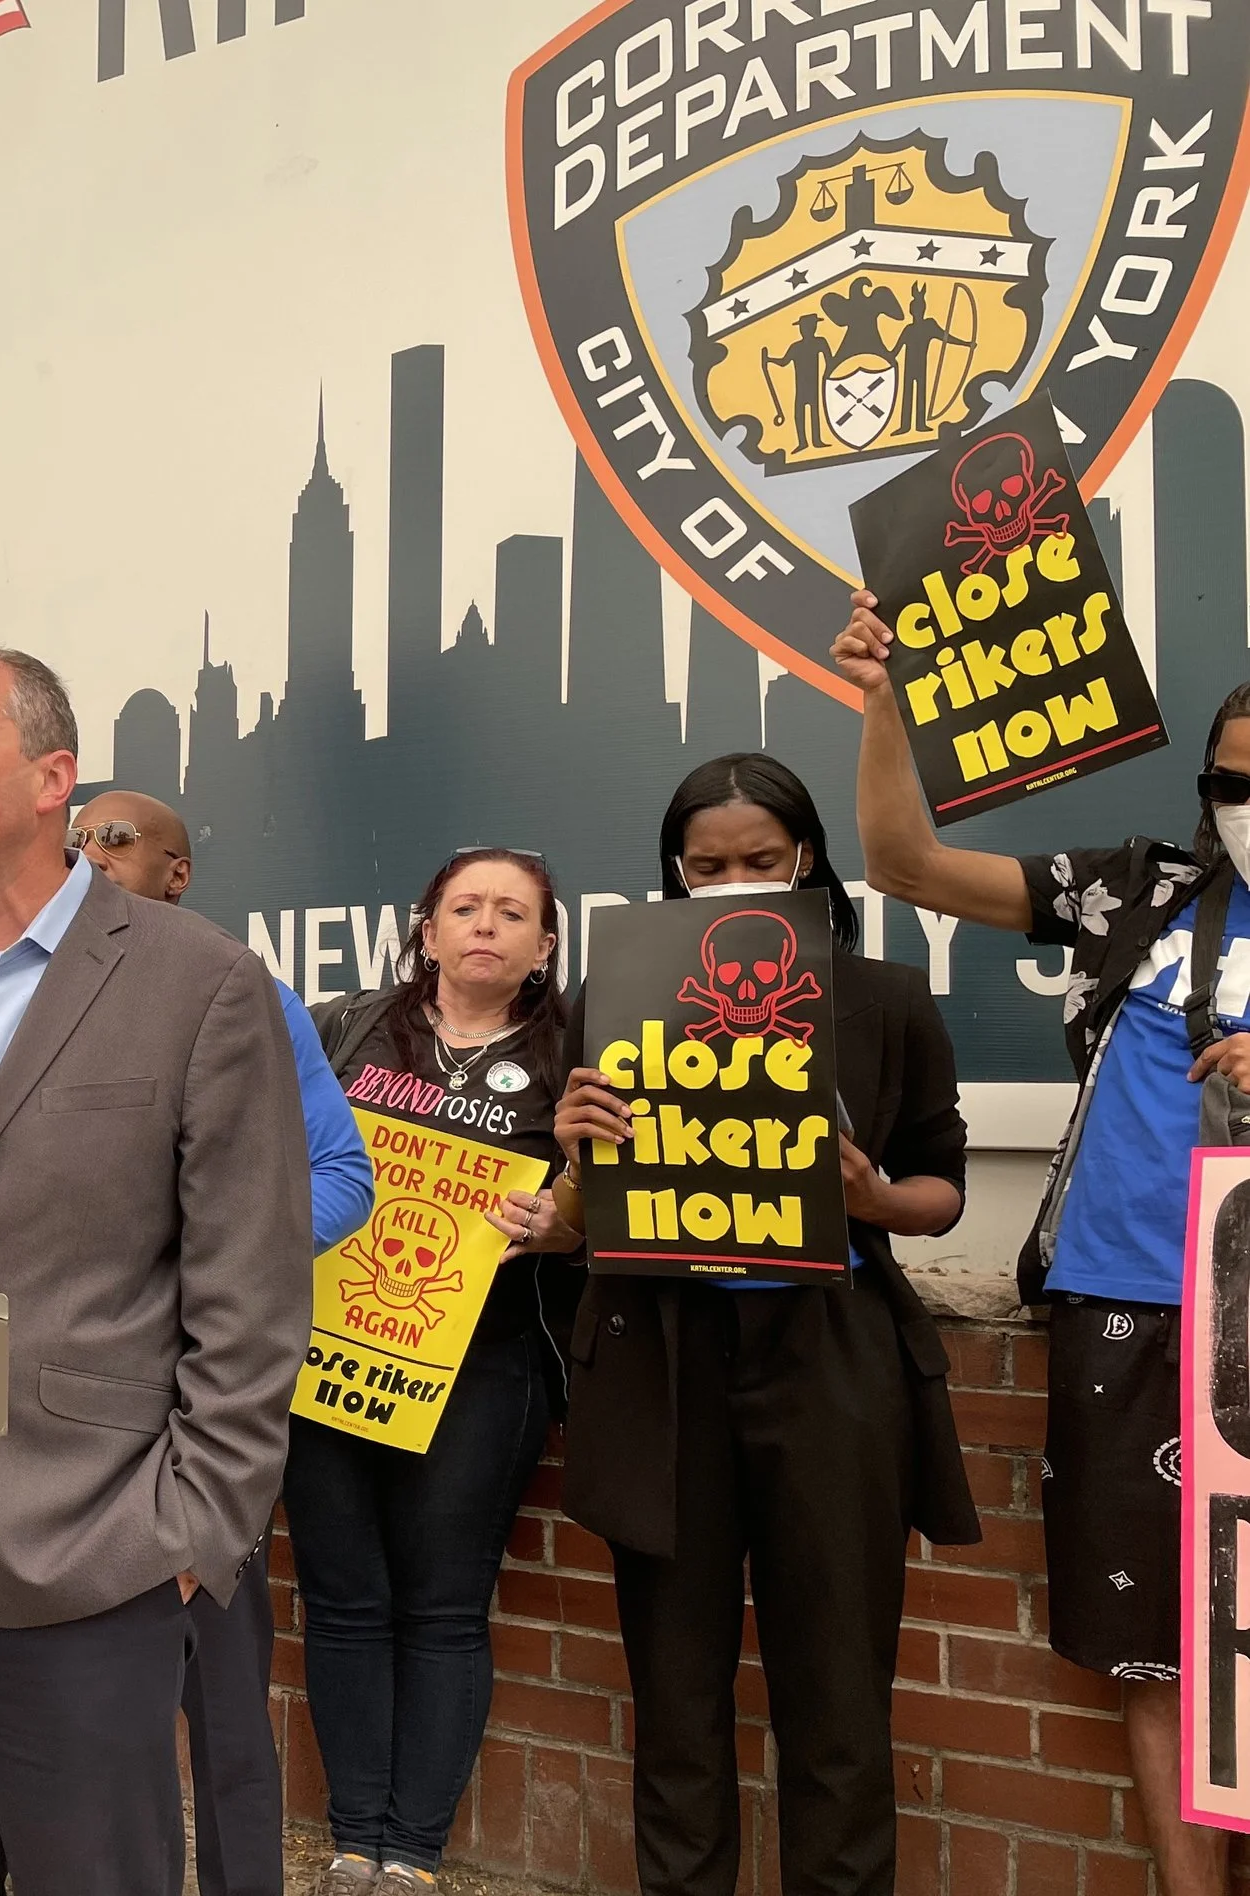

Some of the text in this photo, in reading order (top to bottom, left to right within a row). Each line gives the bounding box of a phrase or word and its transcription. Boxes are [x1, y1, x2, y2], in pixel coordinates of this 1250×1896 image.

[554, 0, 1212, 231] DEPARTMENT
[1066, 109, 1213, 373] YORK
[577, 326, 795, 582] CITY OF
[896, 531, 1081, 649] close
[904, 592, 1111, 726] rikers
[952, 677, 1119, 782] now
[598, 1020, 814, 1091] close
[371, 1125, 510, 1183] DON'T LET
[373, 1157, 425, 1193] YOR
[392, 1207, 440, 1240] KILL
[626, 1188, 803, 1247] now
[344, 1304, 425, 1349] AGAIN
[305, 1346, 446, 1402] ose rikers
[314, 1379, 397, 1424] now
